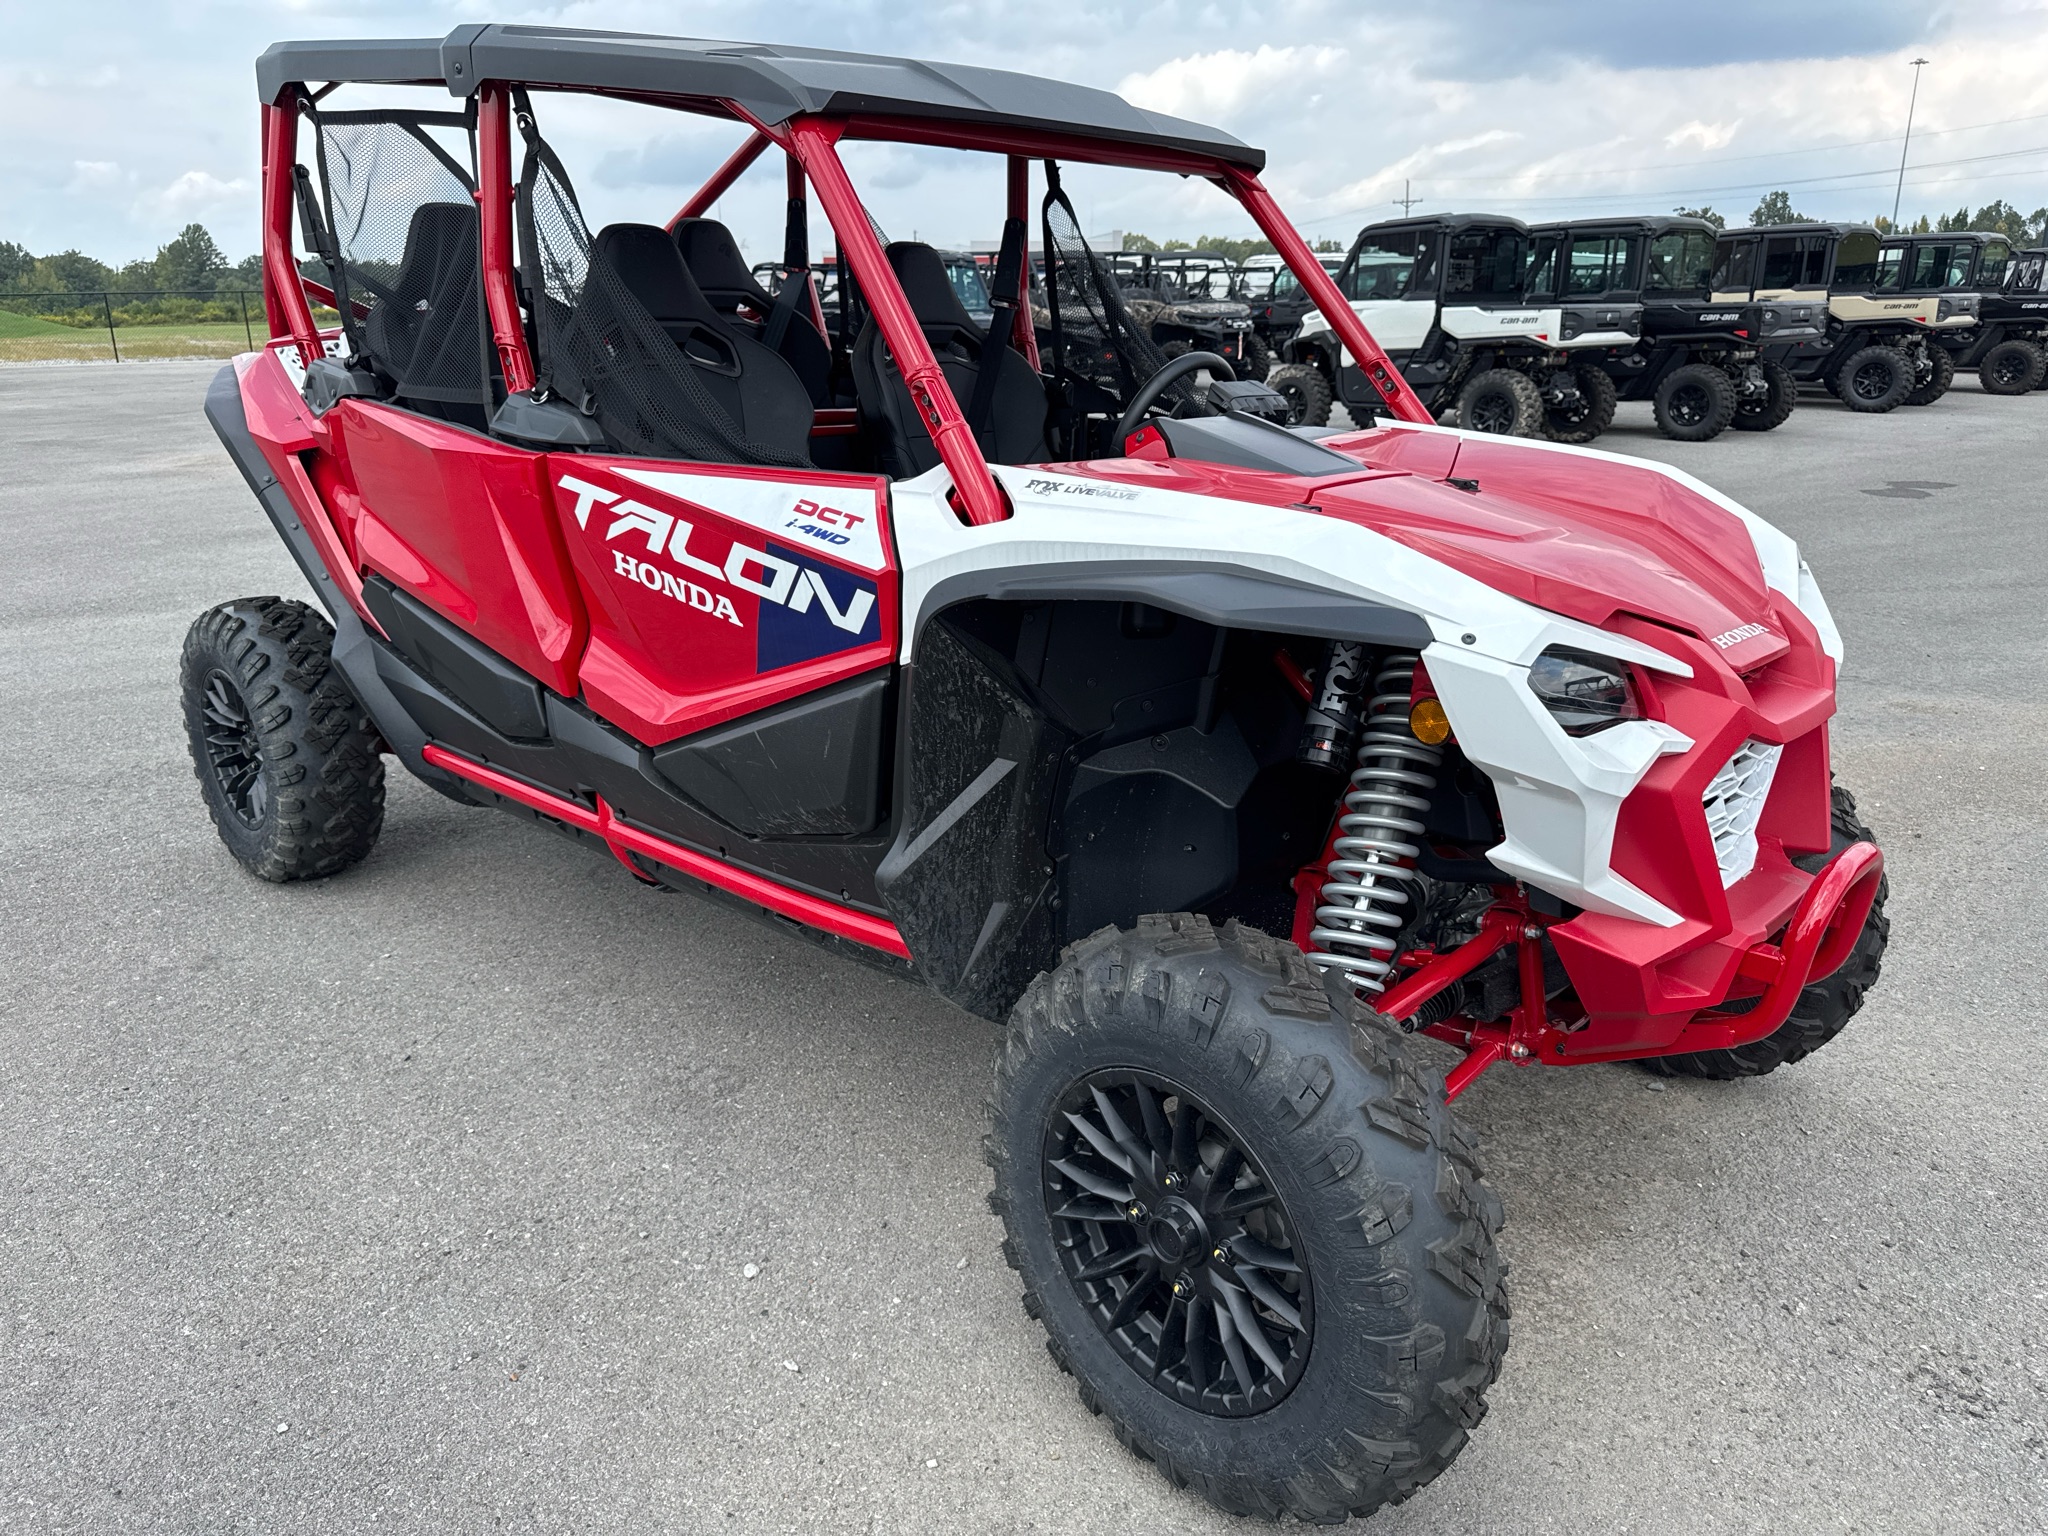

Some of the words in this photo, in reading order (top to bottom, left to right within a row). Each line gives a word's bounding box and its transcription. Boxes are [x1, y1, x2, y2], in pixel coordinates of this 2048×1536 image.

[1699, 313, 1740, 321] can-am
[1025, 479, 1064, 496] FOX
[793, 499, 865, 530] DCT
[784, 518, 851, 545] i-4WD
[557, 474, 876, 635] TALON
[612, 549, 744, 628] HONDA
[1710, 622, 1771, 650] HONDA
[1318, 642, 1364, 715] FOX
